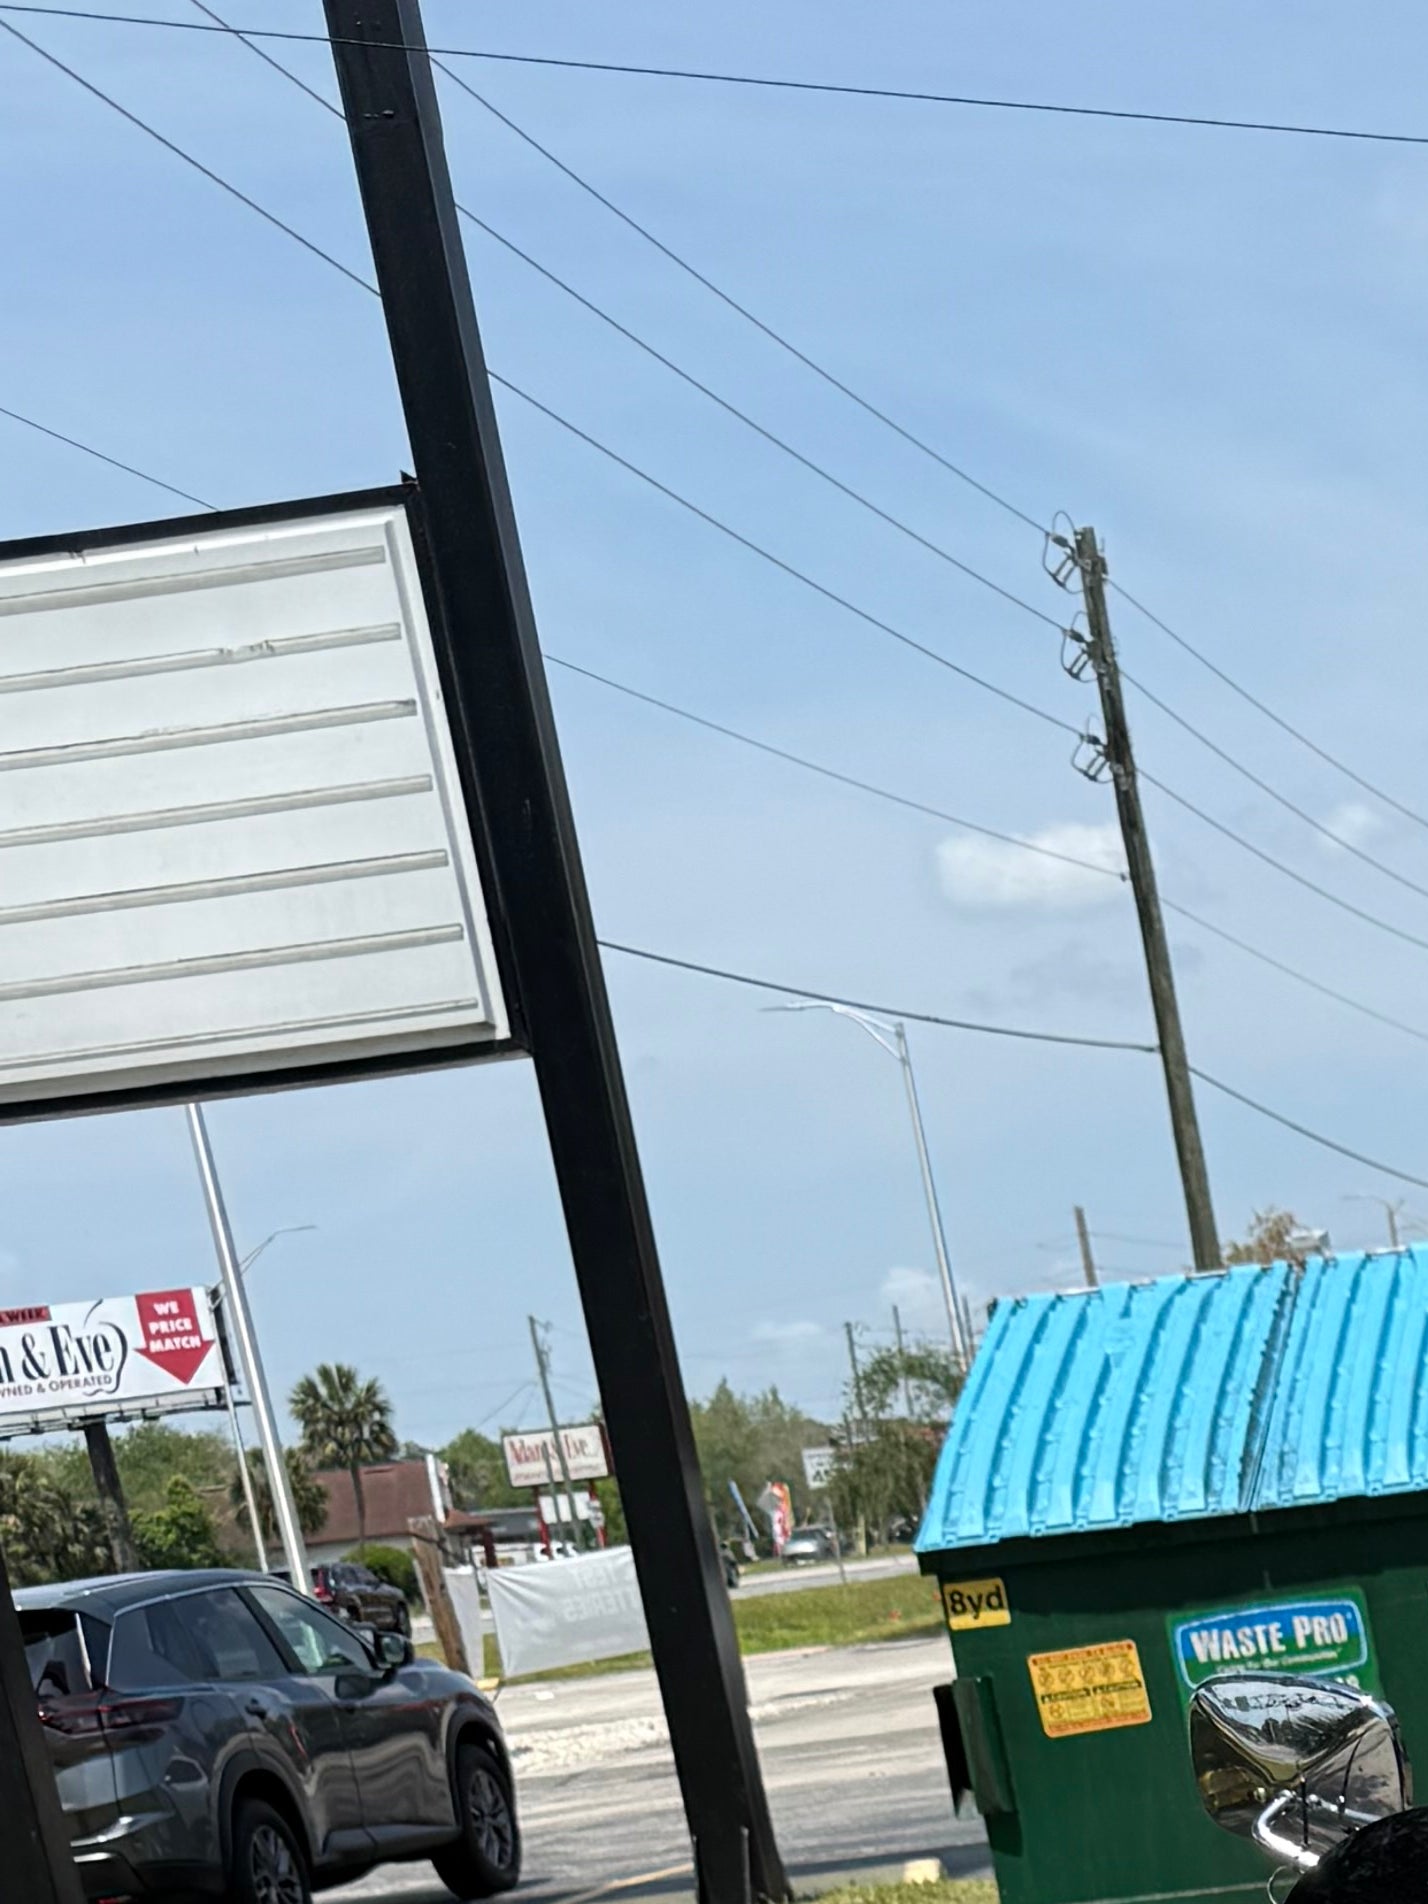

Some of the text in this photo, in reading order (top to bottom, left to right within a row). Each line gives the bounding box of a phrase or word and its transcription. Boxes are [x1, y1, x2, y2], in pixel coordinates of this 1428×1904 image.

[152, 1301, 180, 1316] WE
[148, 1317, 193, 1335] PRICE
[22, 1332, 51, 1381] &
[47, 1324, 115, 1377] Eve
[149, 1335, 202, 1353] MATCH
[49, 1373, 113, 1393] OPERATED
[950, 1585, 1004, 1620] 8yd
[1190, 1621, 1286, 1663] WASTE
[1292, 1611, 1348, 1649] PRO
